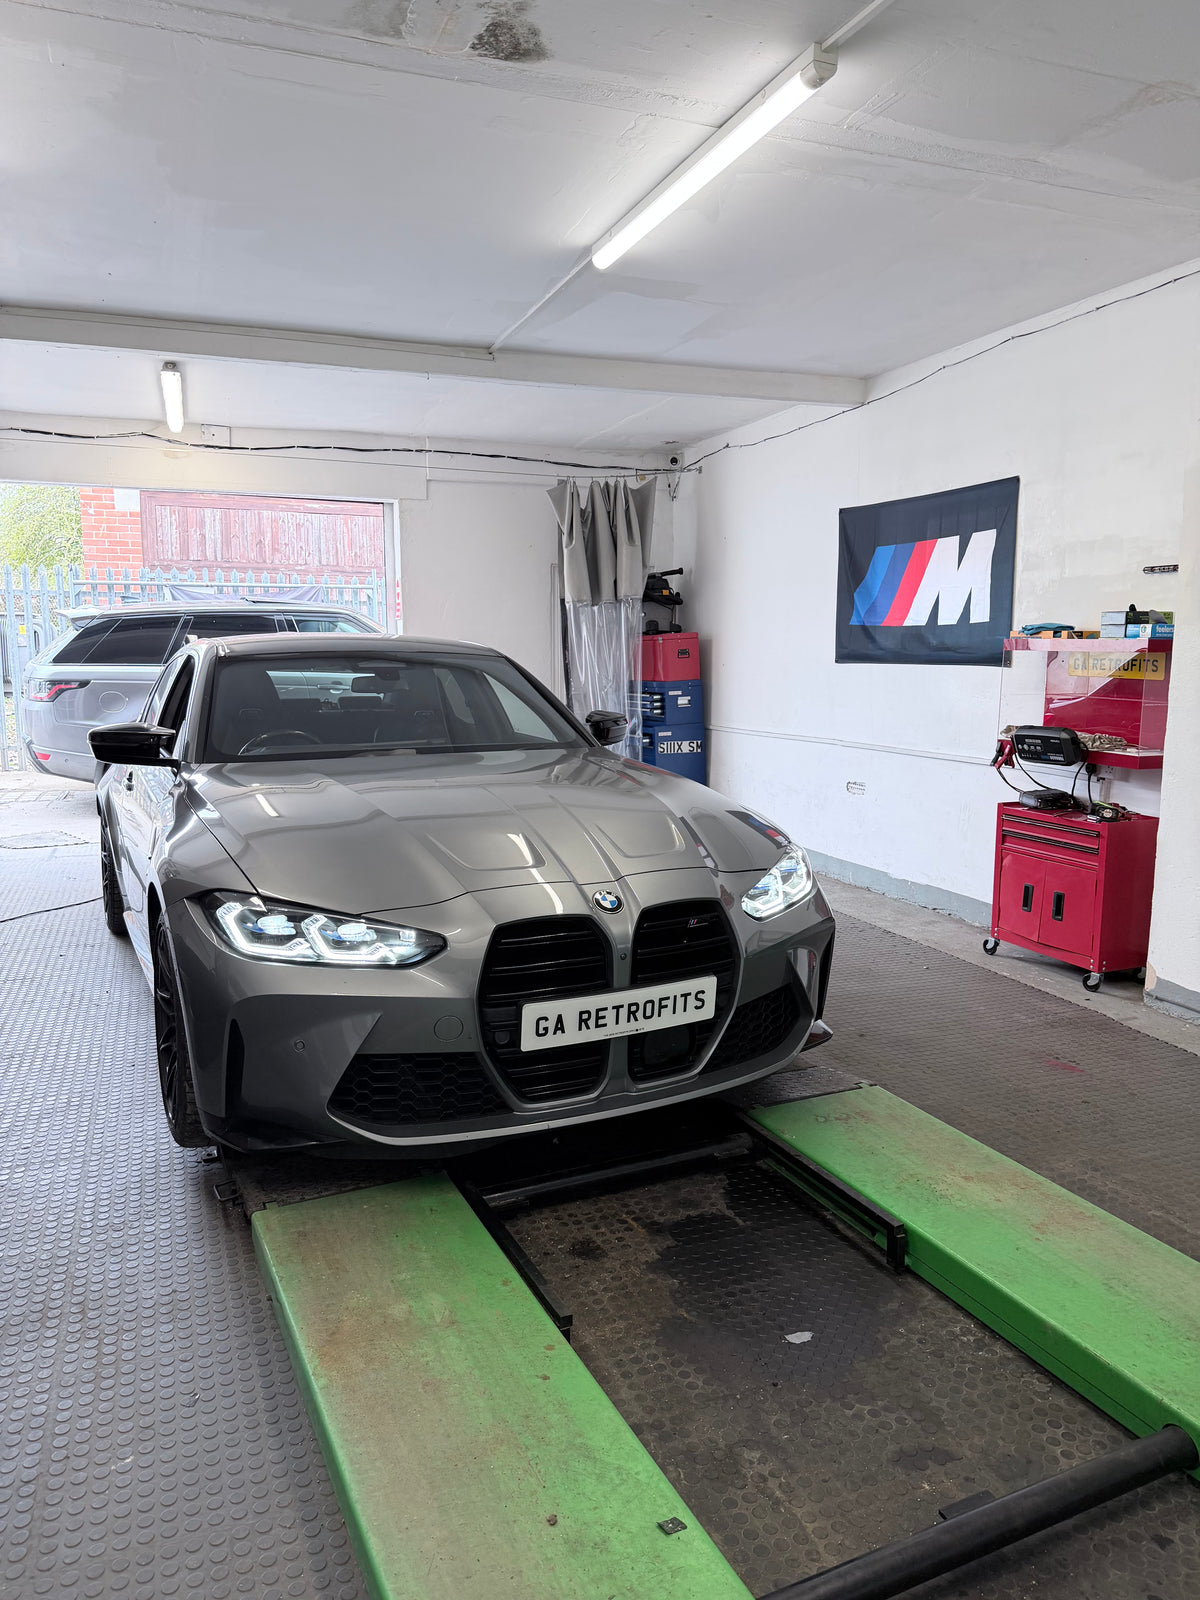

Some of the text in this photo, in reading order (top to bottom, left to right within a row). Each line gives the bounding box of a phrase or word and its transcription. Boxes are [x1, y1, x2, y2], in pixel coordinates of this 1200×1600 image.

[1073, 657, 1159, 673] GA RETROFITS
[535, 989, 706, 1038] GA RETROFITS
